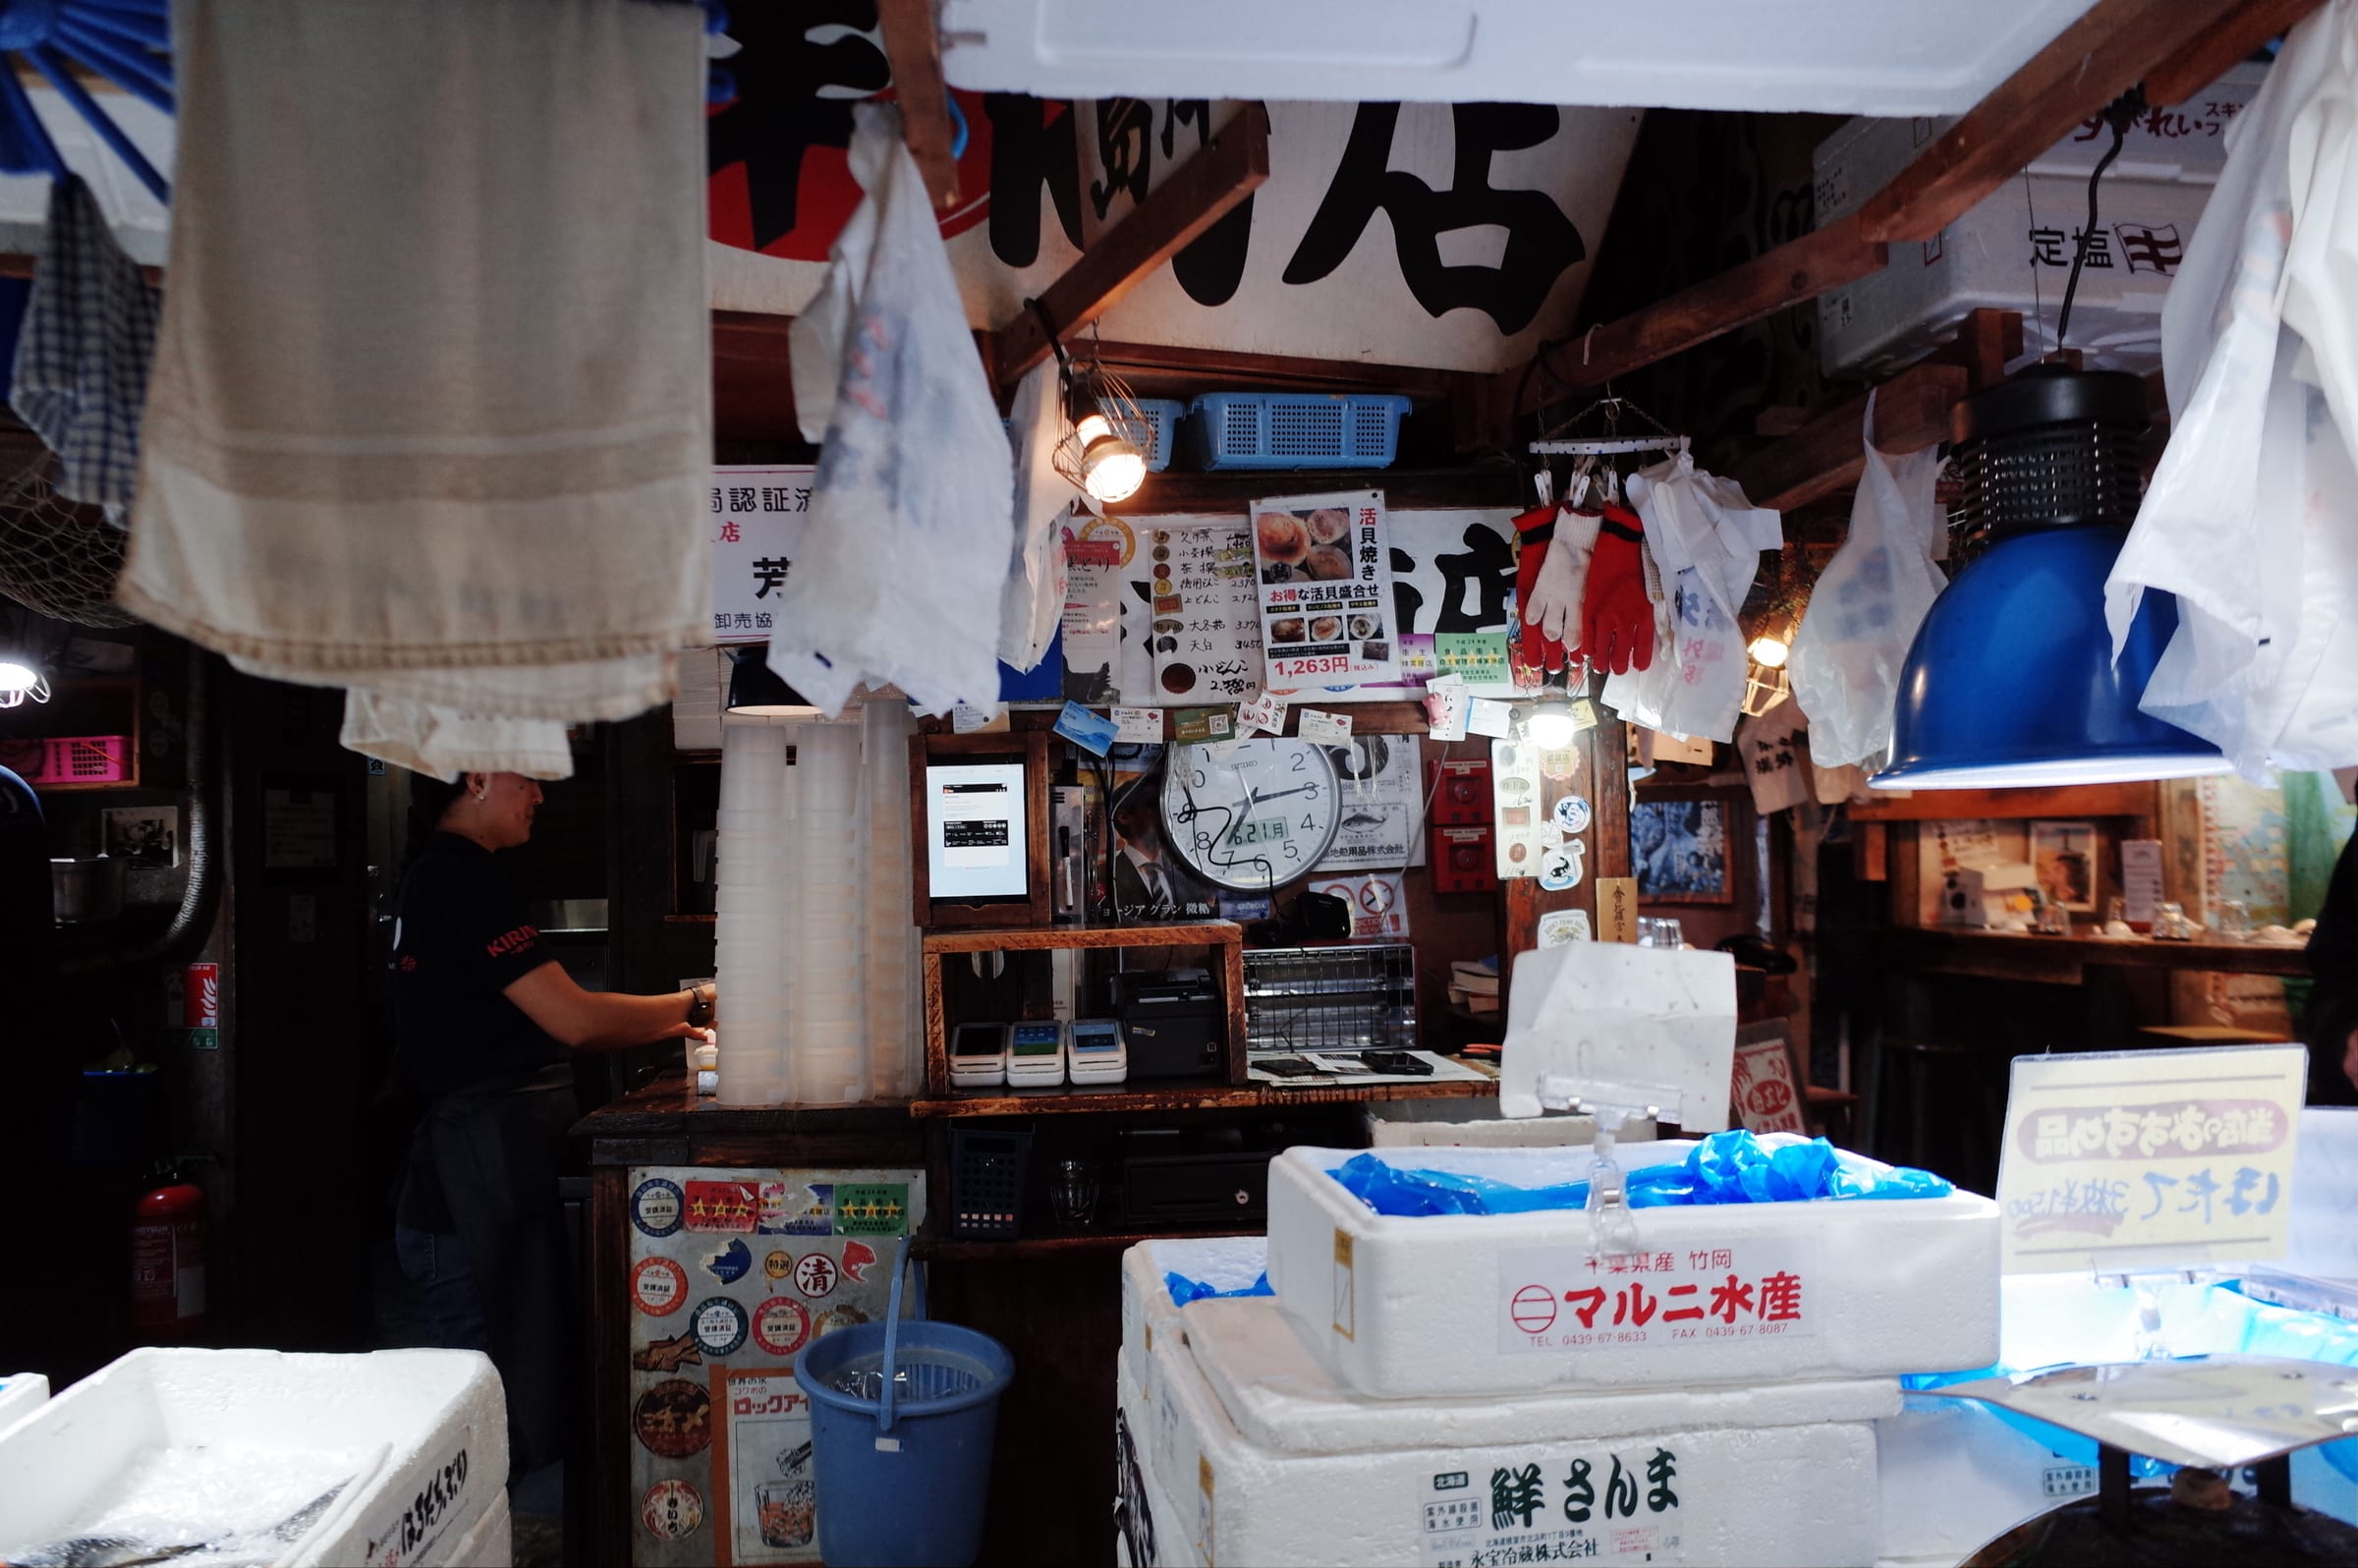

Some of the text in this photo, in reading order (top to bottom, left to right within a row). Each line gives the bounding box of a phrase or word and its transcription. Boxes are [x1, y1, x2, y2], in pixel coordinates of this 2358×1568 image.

[2206, 102, 2245, 118] スキ
[2029, 226, 2113, 269] 定塩
[1359, 507, 1378, 581] 活貝焼き
[1269, 584, 1379, 602] お得な活貝盛合せ
[1274, 656, 1349, 678] 1,263円
[1290, 753, 1306, 772] 2
[1303, 781, 1319, 800] 3
[1300, 812, 1317, 831] 4
[1197, 831, 1212, 850] 8
[1283, 840, 1298, 859] 5
[1220, 850, 1235, 869] 7
[1254, 854, 1268, 872] 6
[1092, 904, 1146, 917] ョージア
[486, 924, 538, 958] KIRIN
[768, 1260, 790, 1270] 特選
[1584, 1249, 1732, 1276] 千葉県産 竹岡
[802, 1259, 833, 1292] 清
[1530, 1335, 1553, 1348] TEL
[1672, 1328, 1697, 1339] FAX
[1435, 1474, 1467, 1487] 北海道
